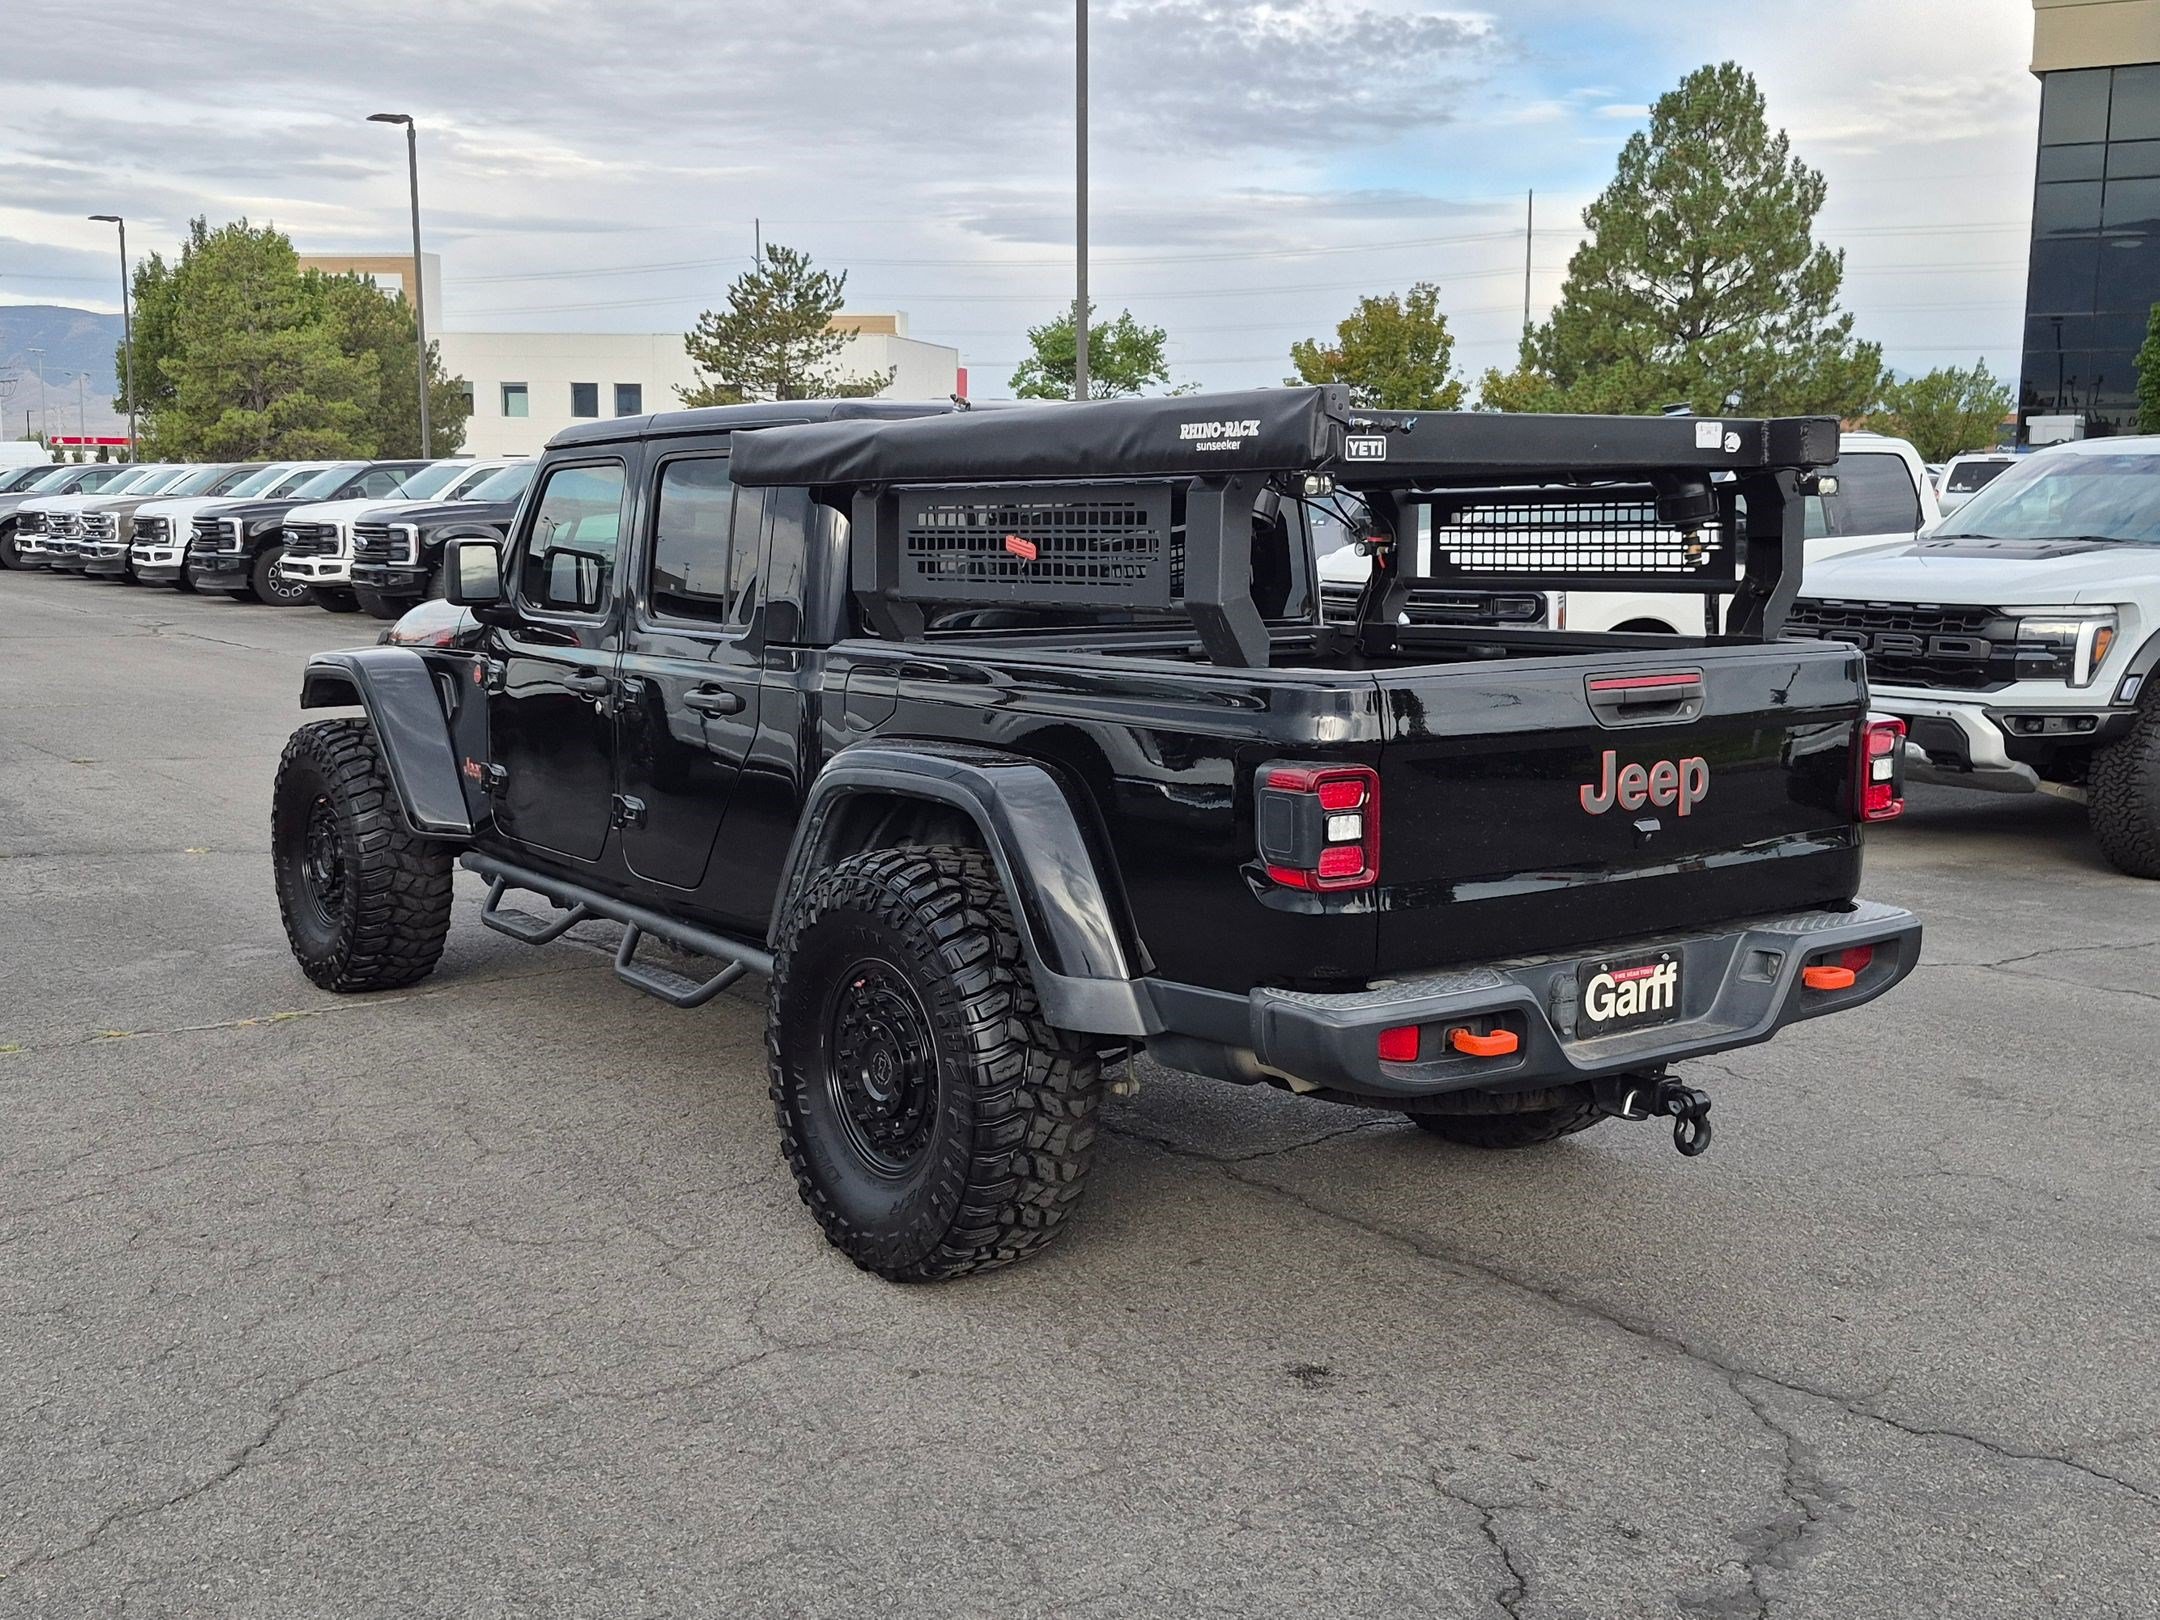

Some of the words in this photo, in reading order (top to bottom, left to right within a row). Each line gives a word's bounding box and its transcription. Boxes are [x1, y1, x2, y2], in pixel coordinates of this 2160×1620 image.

[1180, 420, 1261, 440] RHINO-RACK
[1196, 440, 1241, 451] sunseeker
[1348, 441, 1383, 456] YETI
[1580, 750, 1709, 816] Jeep
[1585, 961, 1678, 1022] Garff
